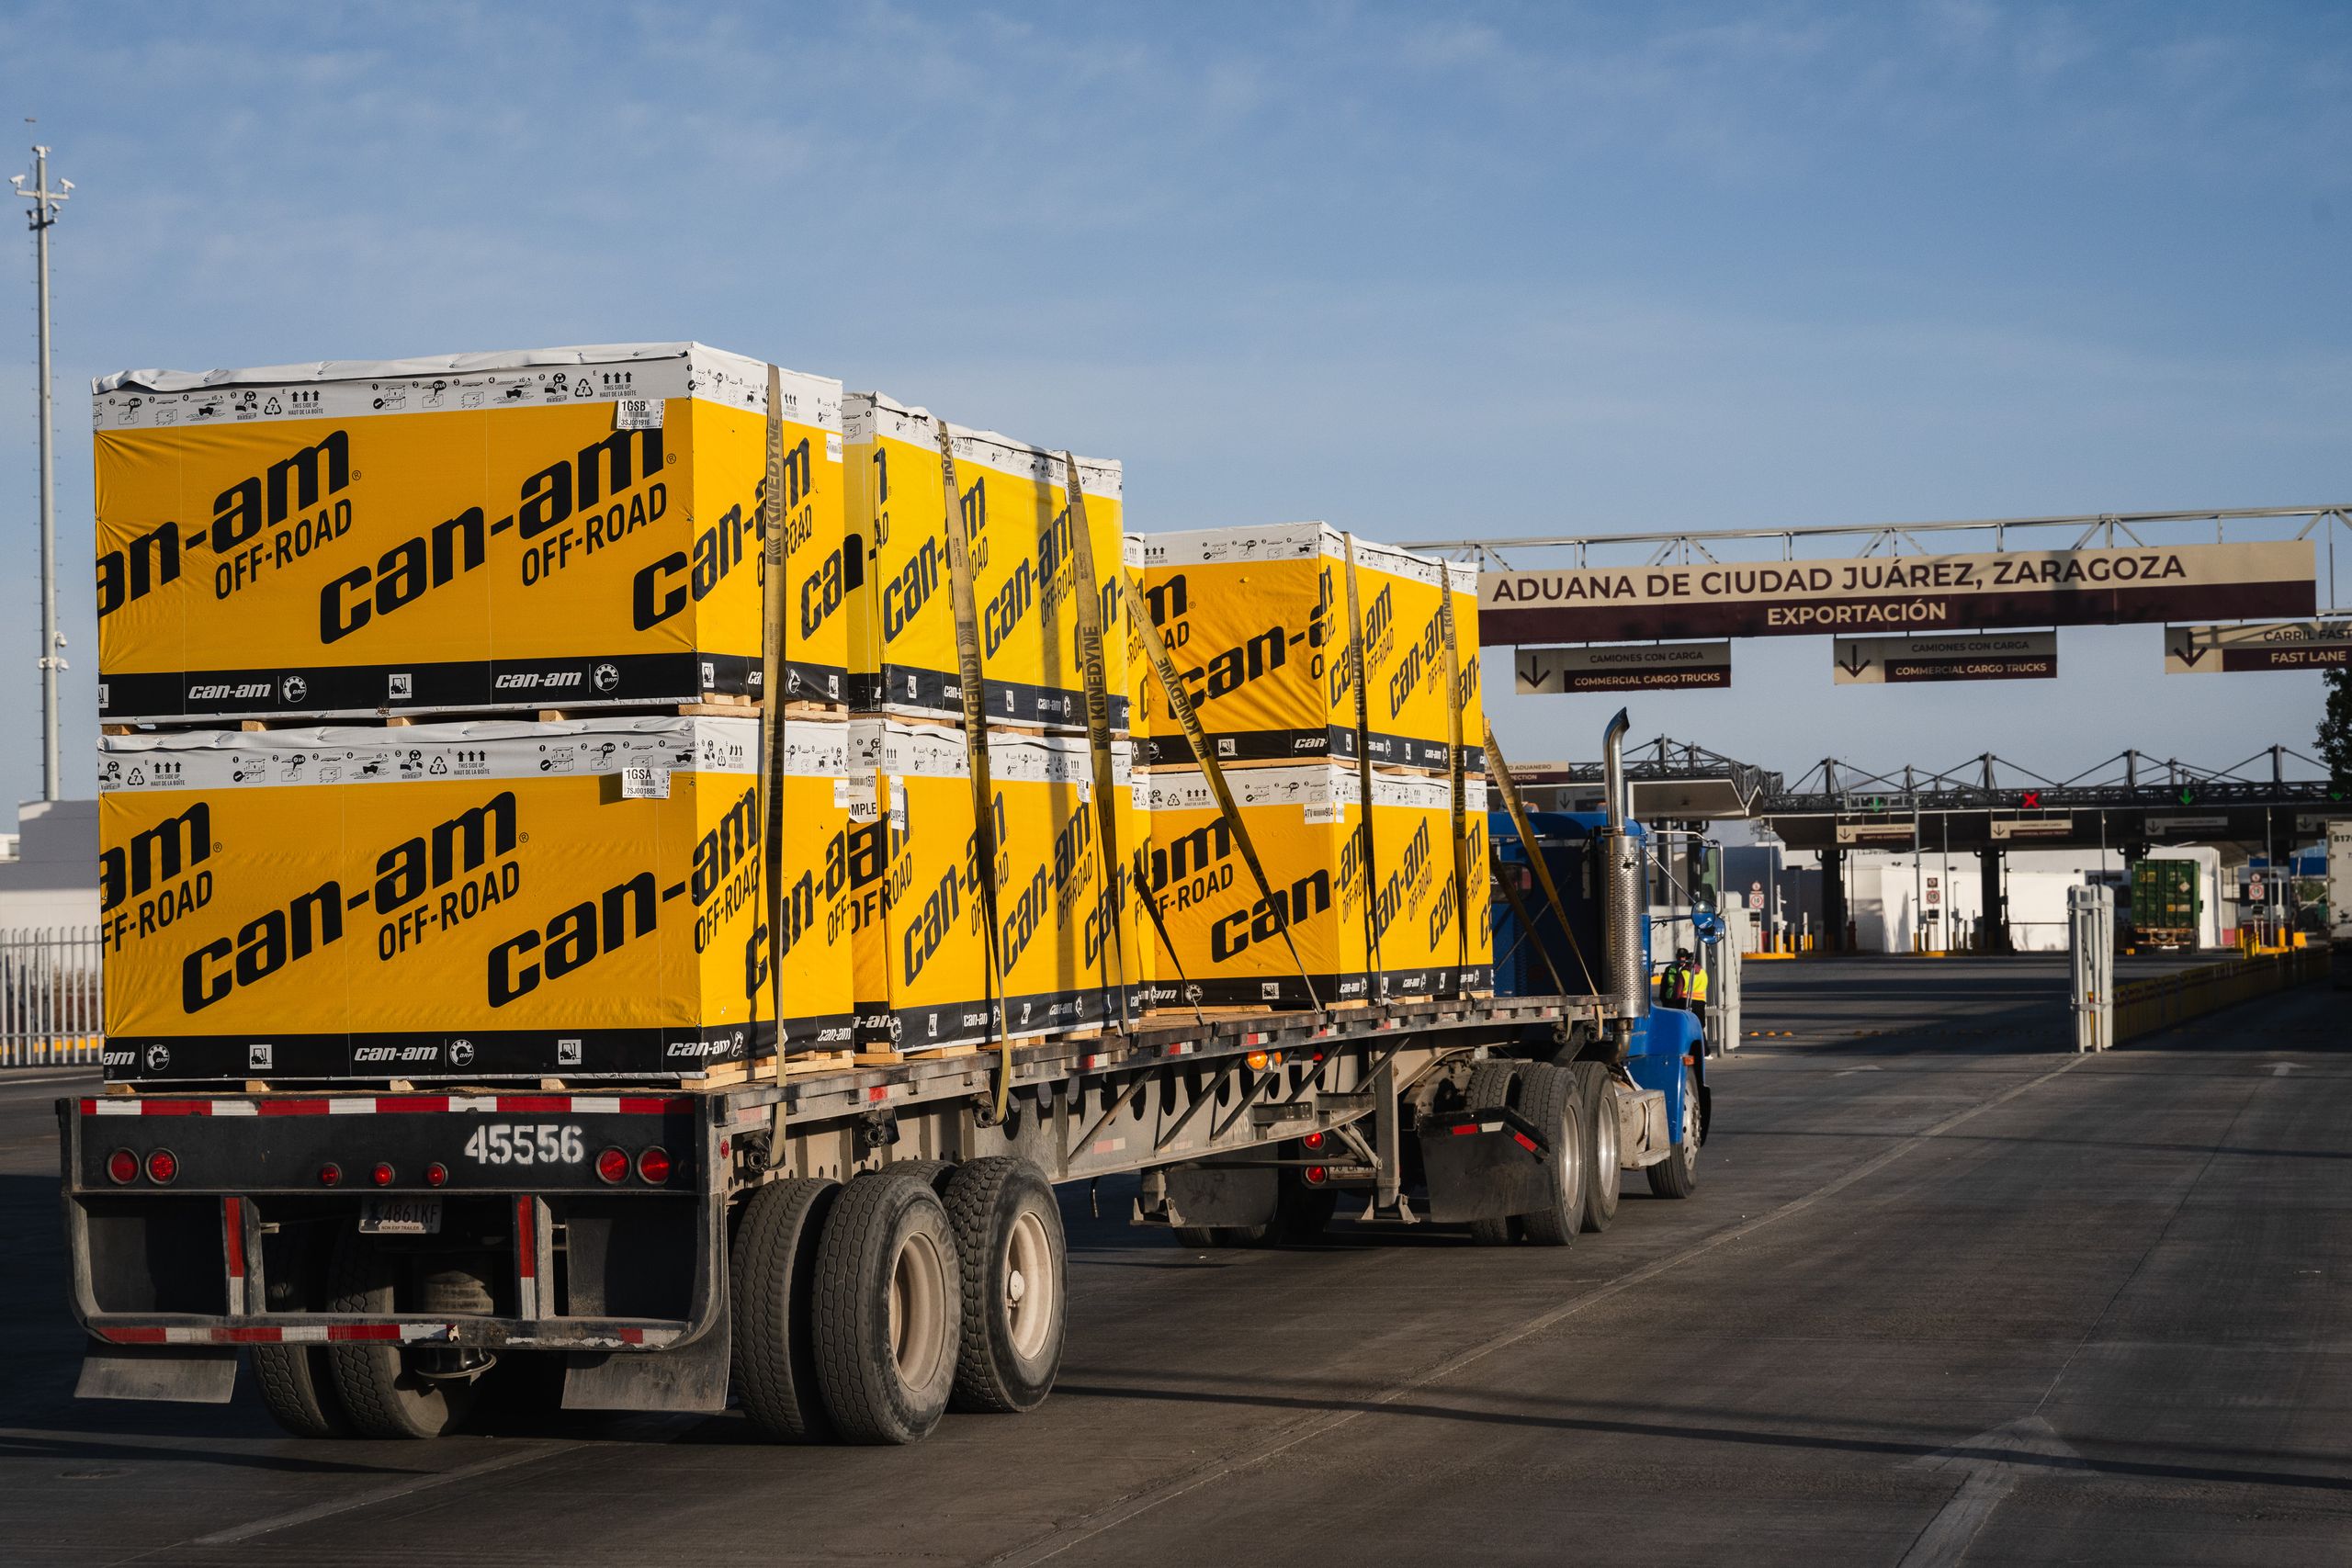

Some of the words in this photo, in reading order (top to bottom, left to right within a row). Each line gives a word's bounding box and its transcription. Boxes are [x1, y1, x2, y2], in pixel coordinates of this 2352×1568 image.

[624, 388, 637, 396] BOÎTE
[621, 400, 646, 412] 1GSB
[767, 417, 782, 530] KINEDYNE
[319, 428, 664, 644] can-am
[521, 481, 667, 587] OFF-ROAD
[214, 497, 352, 600] OFF-ROAD
[1492, 576, 1636, 602] ADUANA
[1647, 573, 1691, 597] DE
[1701, 567, 1833, 595] CIUDAD
[1842, 558, 1984, 591] JUÁREZ,
[1993, 554, 2187, 585] ZARAGOZA
[1767, 598, 1947, 626] EXPORTACIÓN
[2263, 630, 2315, 642] CARRIL
[1911, 643, 1966, 653] CAMIONES
[1968, 642, 1990, 651] CON
[1992, 641, 2030, 650] CARGA
[1589, 652, 1642, 663] CAMIONES
[1645, 652, 1666, 661] CON
[1668, 651, 1703, 660] CARGA
[2270, 652, 2306, 663] FAST
[2309, 650, 2346, 662] LANE
[1082, 626, 1106, 721] KINEDYNE
[1895, 665, 1964, 676] COMMERCIAL
[1966, 664, 2004, 674] CARGO
[2006, 662, 2047, 673] TRUCKS
[494, 671, 582, 689] can-am
[1574, 675, 1642, 686] COMMERCIAL
[1644, 673, 1679, 683] CARGO
[1680, 672, 1721, 682] TRUCKS
[188, 682, 271, 700] can-am
[1154, 656, 1200, 736] KINEDYNE
[961, 652, 987, 755] KINEDYNE
[1037, 696, 1061, 712] can-am
[1425, 749, 1442, 760] can-am
[626, 769, 652, 780] 1GSA
[1516, 763, 1552, 772] ADUANERO
[865, 775, 876, 788] 1537
[1452, 744, 1465, 817] KINEDYNE
[1002, 801, 1091, 978] can-am
[1057, 851, 1092, 932] OFF-ROAD
[1408, 860, 1433, 923] OFF-ROAD
[183, 791, 516, 1014] can-am
[378, 860, 519, 962] OFF-ROAD
[695, 855, 760, 954] OFF-ROAD
[1339, 982, 1361, 994] can-am
[818, 1027, 851, 1043] can-am
[355, 1045, 437, 1061] can-am
[666, 1039, 730, 1057] can-am
[464, 1124, 584, 1165] 45556
